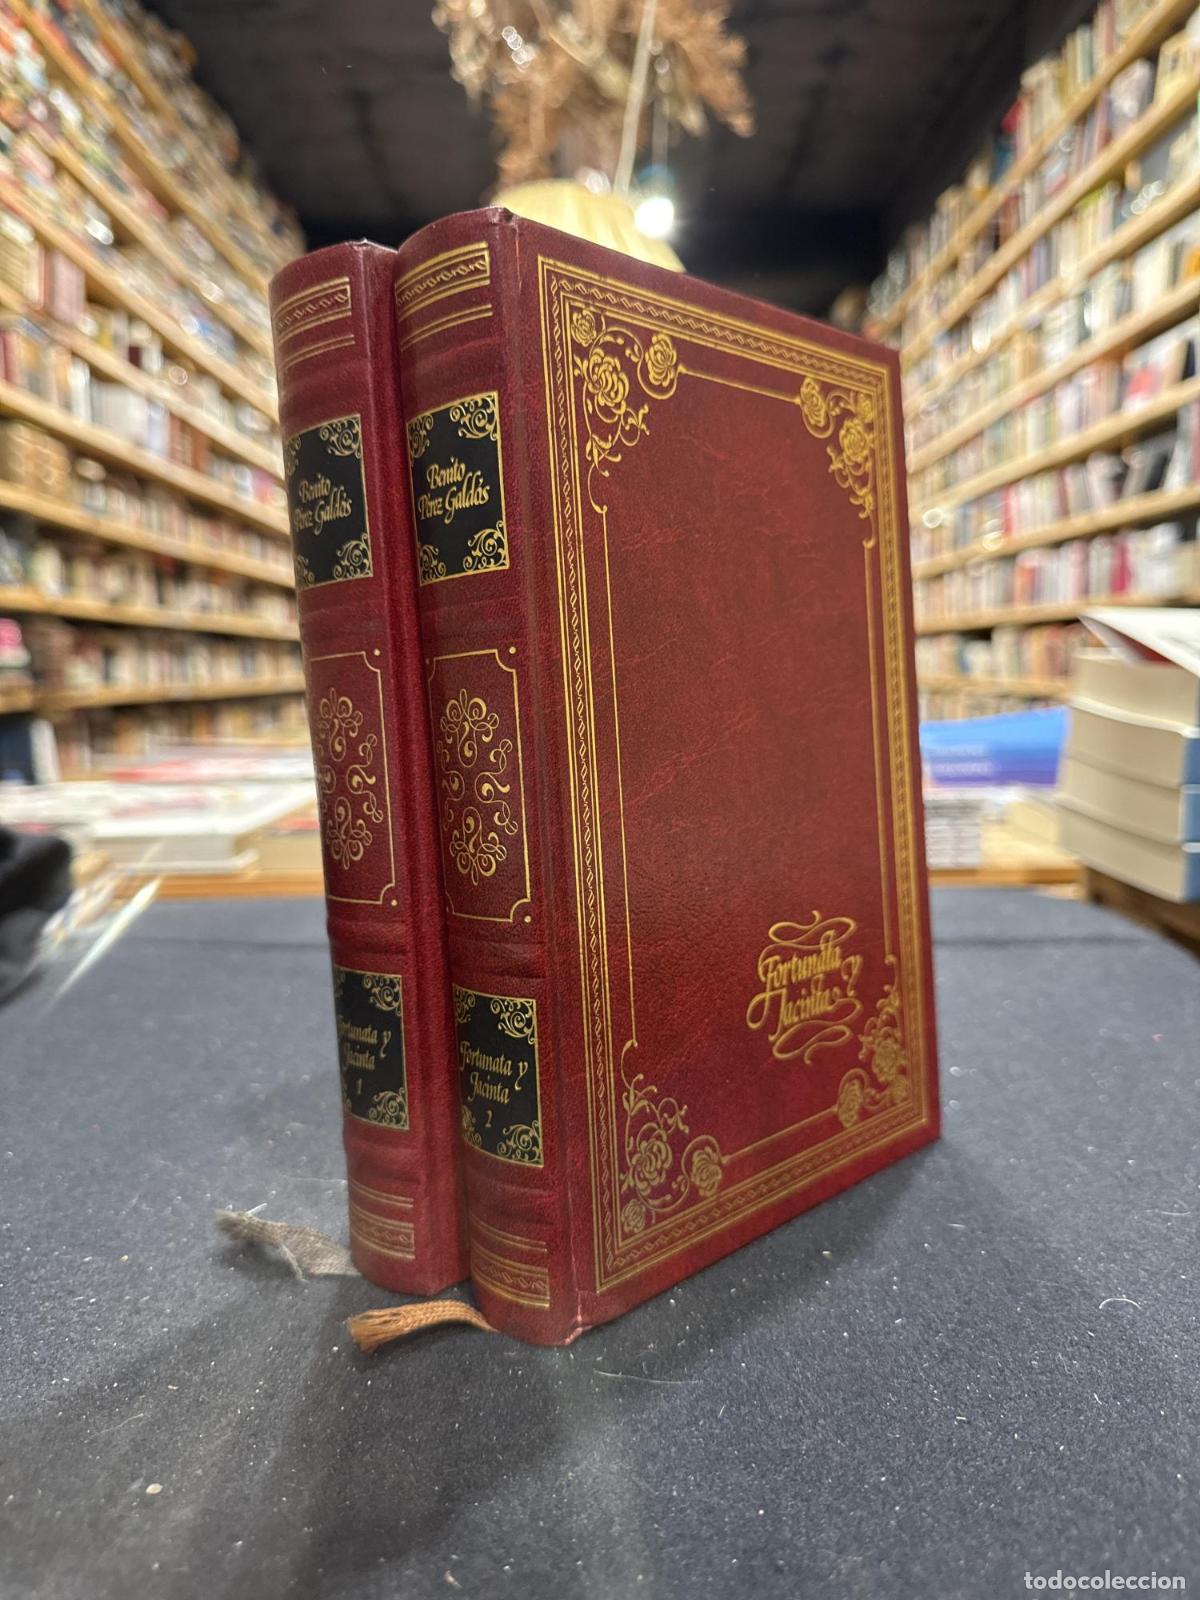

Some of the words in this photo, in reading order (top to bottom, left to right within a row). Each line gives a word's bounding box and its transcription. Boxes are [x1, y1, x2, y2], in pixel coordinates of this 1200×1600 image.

[299, 473, 332, 503] Benito
[427, 457, 466, 490] Benito
[841, 954, 863, 997] y
[380, 1030, 392, 1059] y
[460, 1041, 513, 1076] Fortunata
[514, 1061, 529, 1091] y
[356, 1078, 363, 1095] 1
[467, 1072, 510, 1105] Jacinta
[485, 1110, 493, 1128] 2
